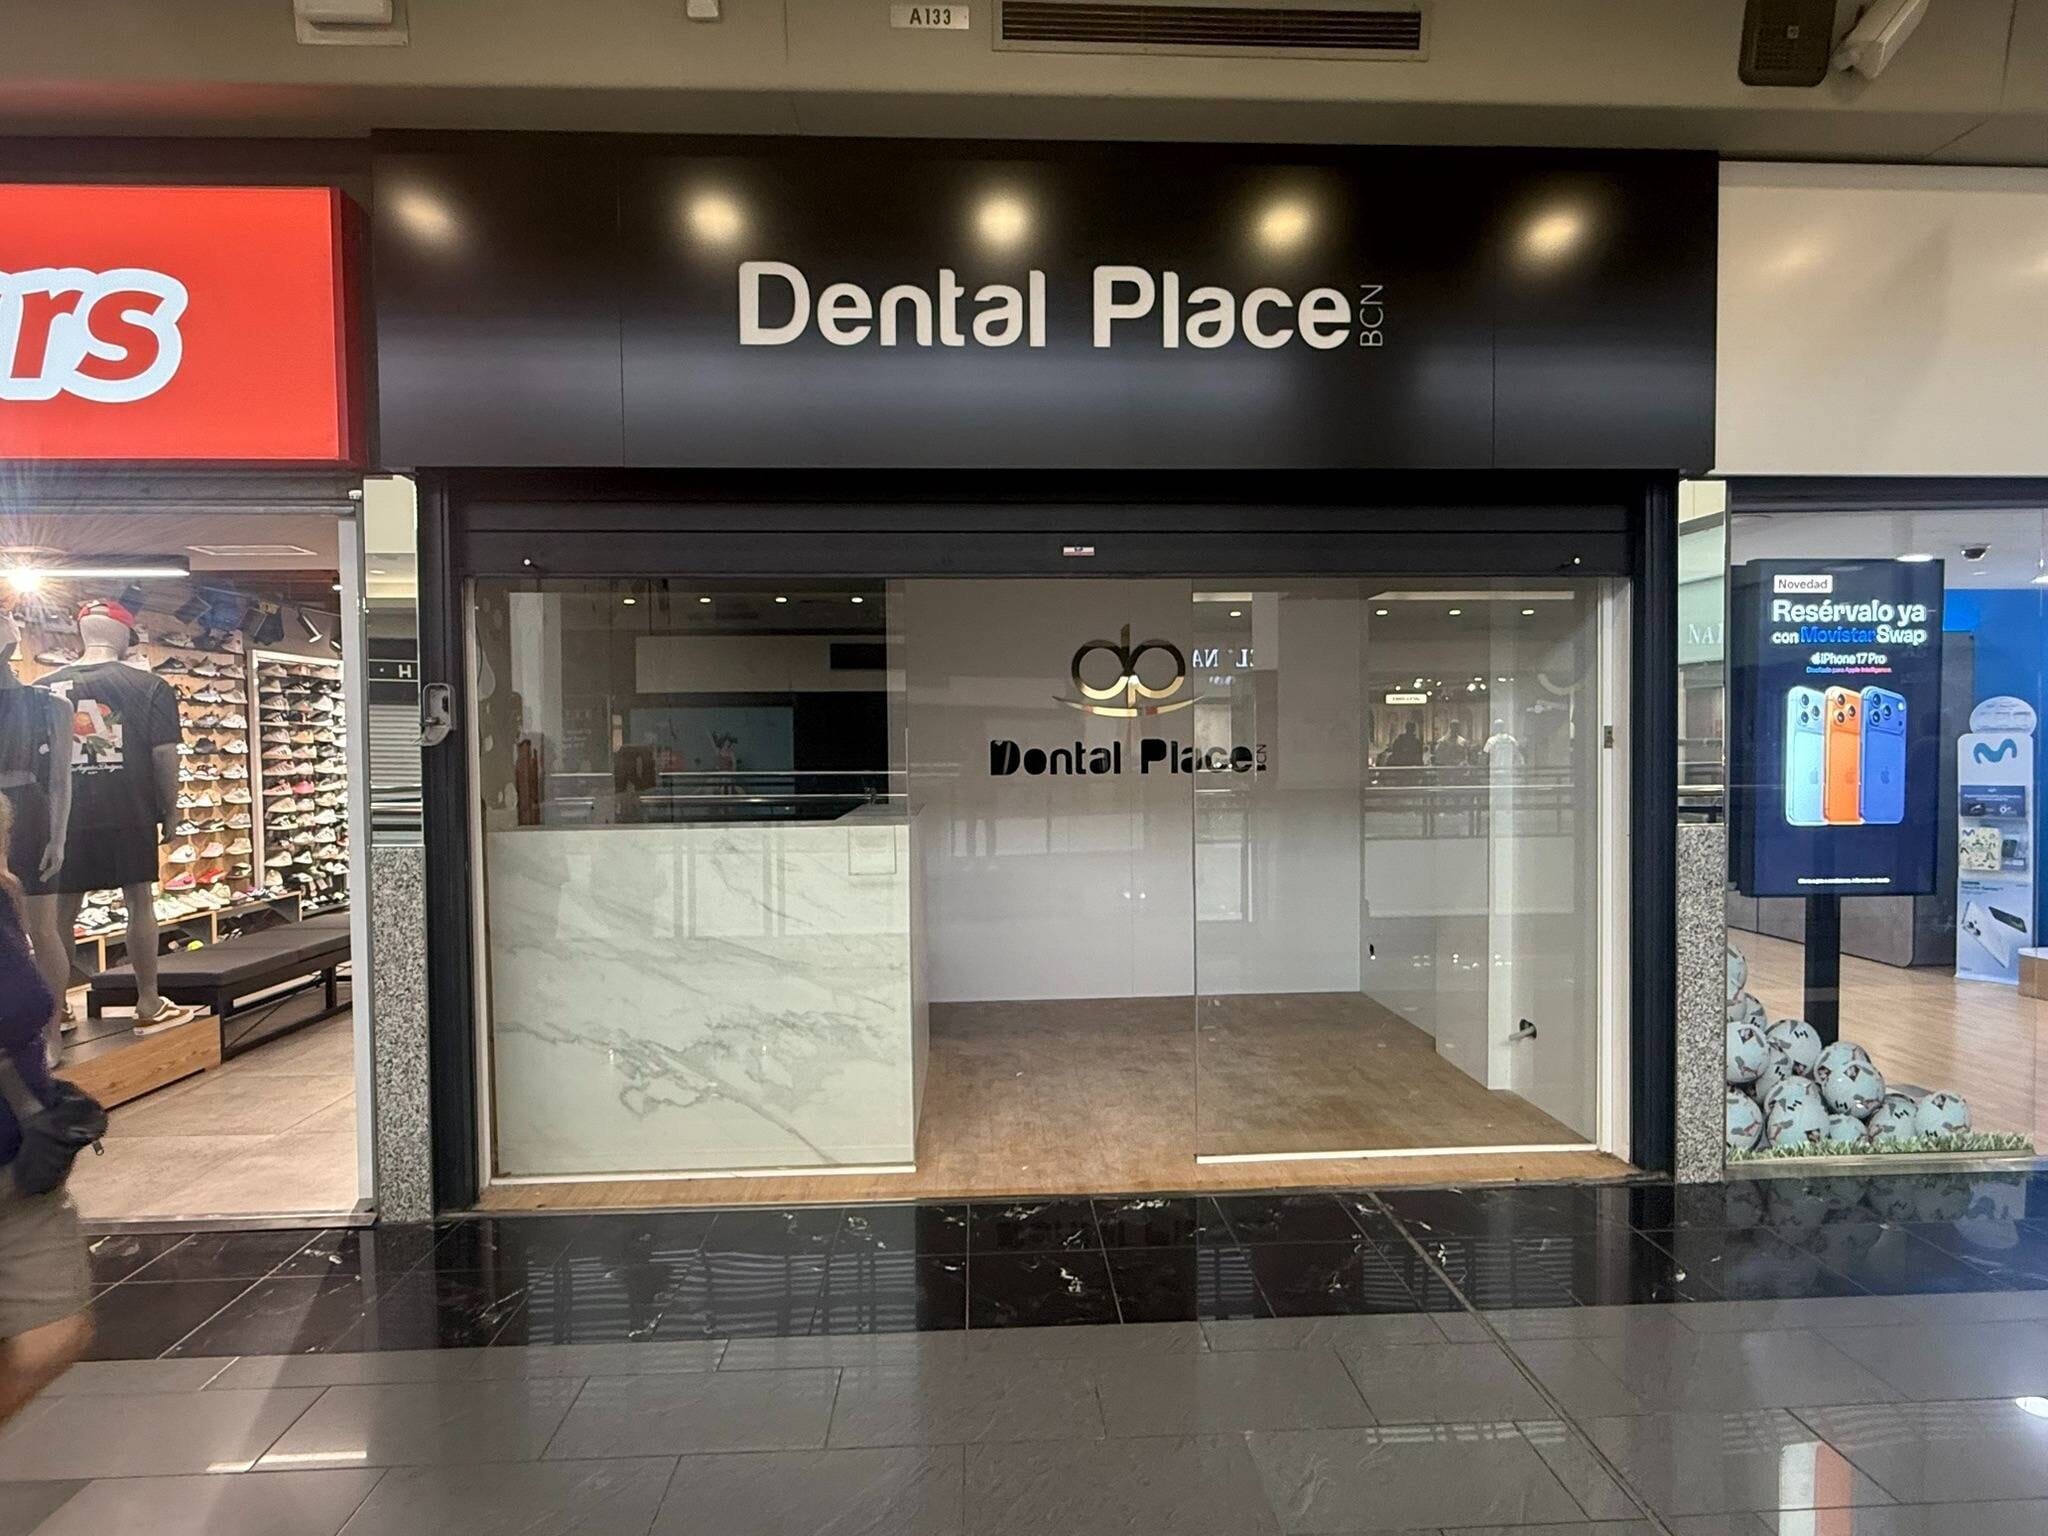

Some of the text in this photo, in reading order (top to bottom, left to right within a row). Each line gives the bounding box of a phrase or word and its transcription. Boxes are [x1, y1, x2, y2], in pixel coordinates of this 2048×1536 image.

[909, 7, 951, 25] A133
[738, 261, 1352, 350] Dental Place
[1359, 284, 1384, 347] BCN
[0, 284, 176, 390] rs
[1777, 578, 1829, 590] Novedad
[1771, 598, 1927, 627] Resérvalo ya
[1771, 623, 1928, 646] con Movistar Swap
[1820, 652, 1856, 665] iPhone
[1867, 652, 1888, 665] Pro
[1140, 738, 1253, 775] Place
